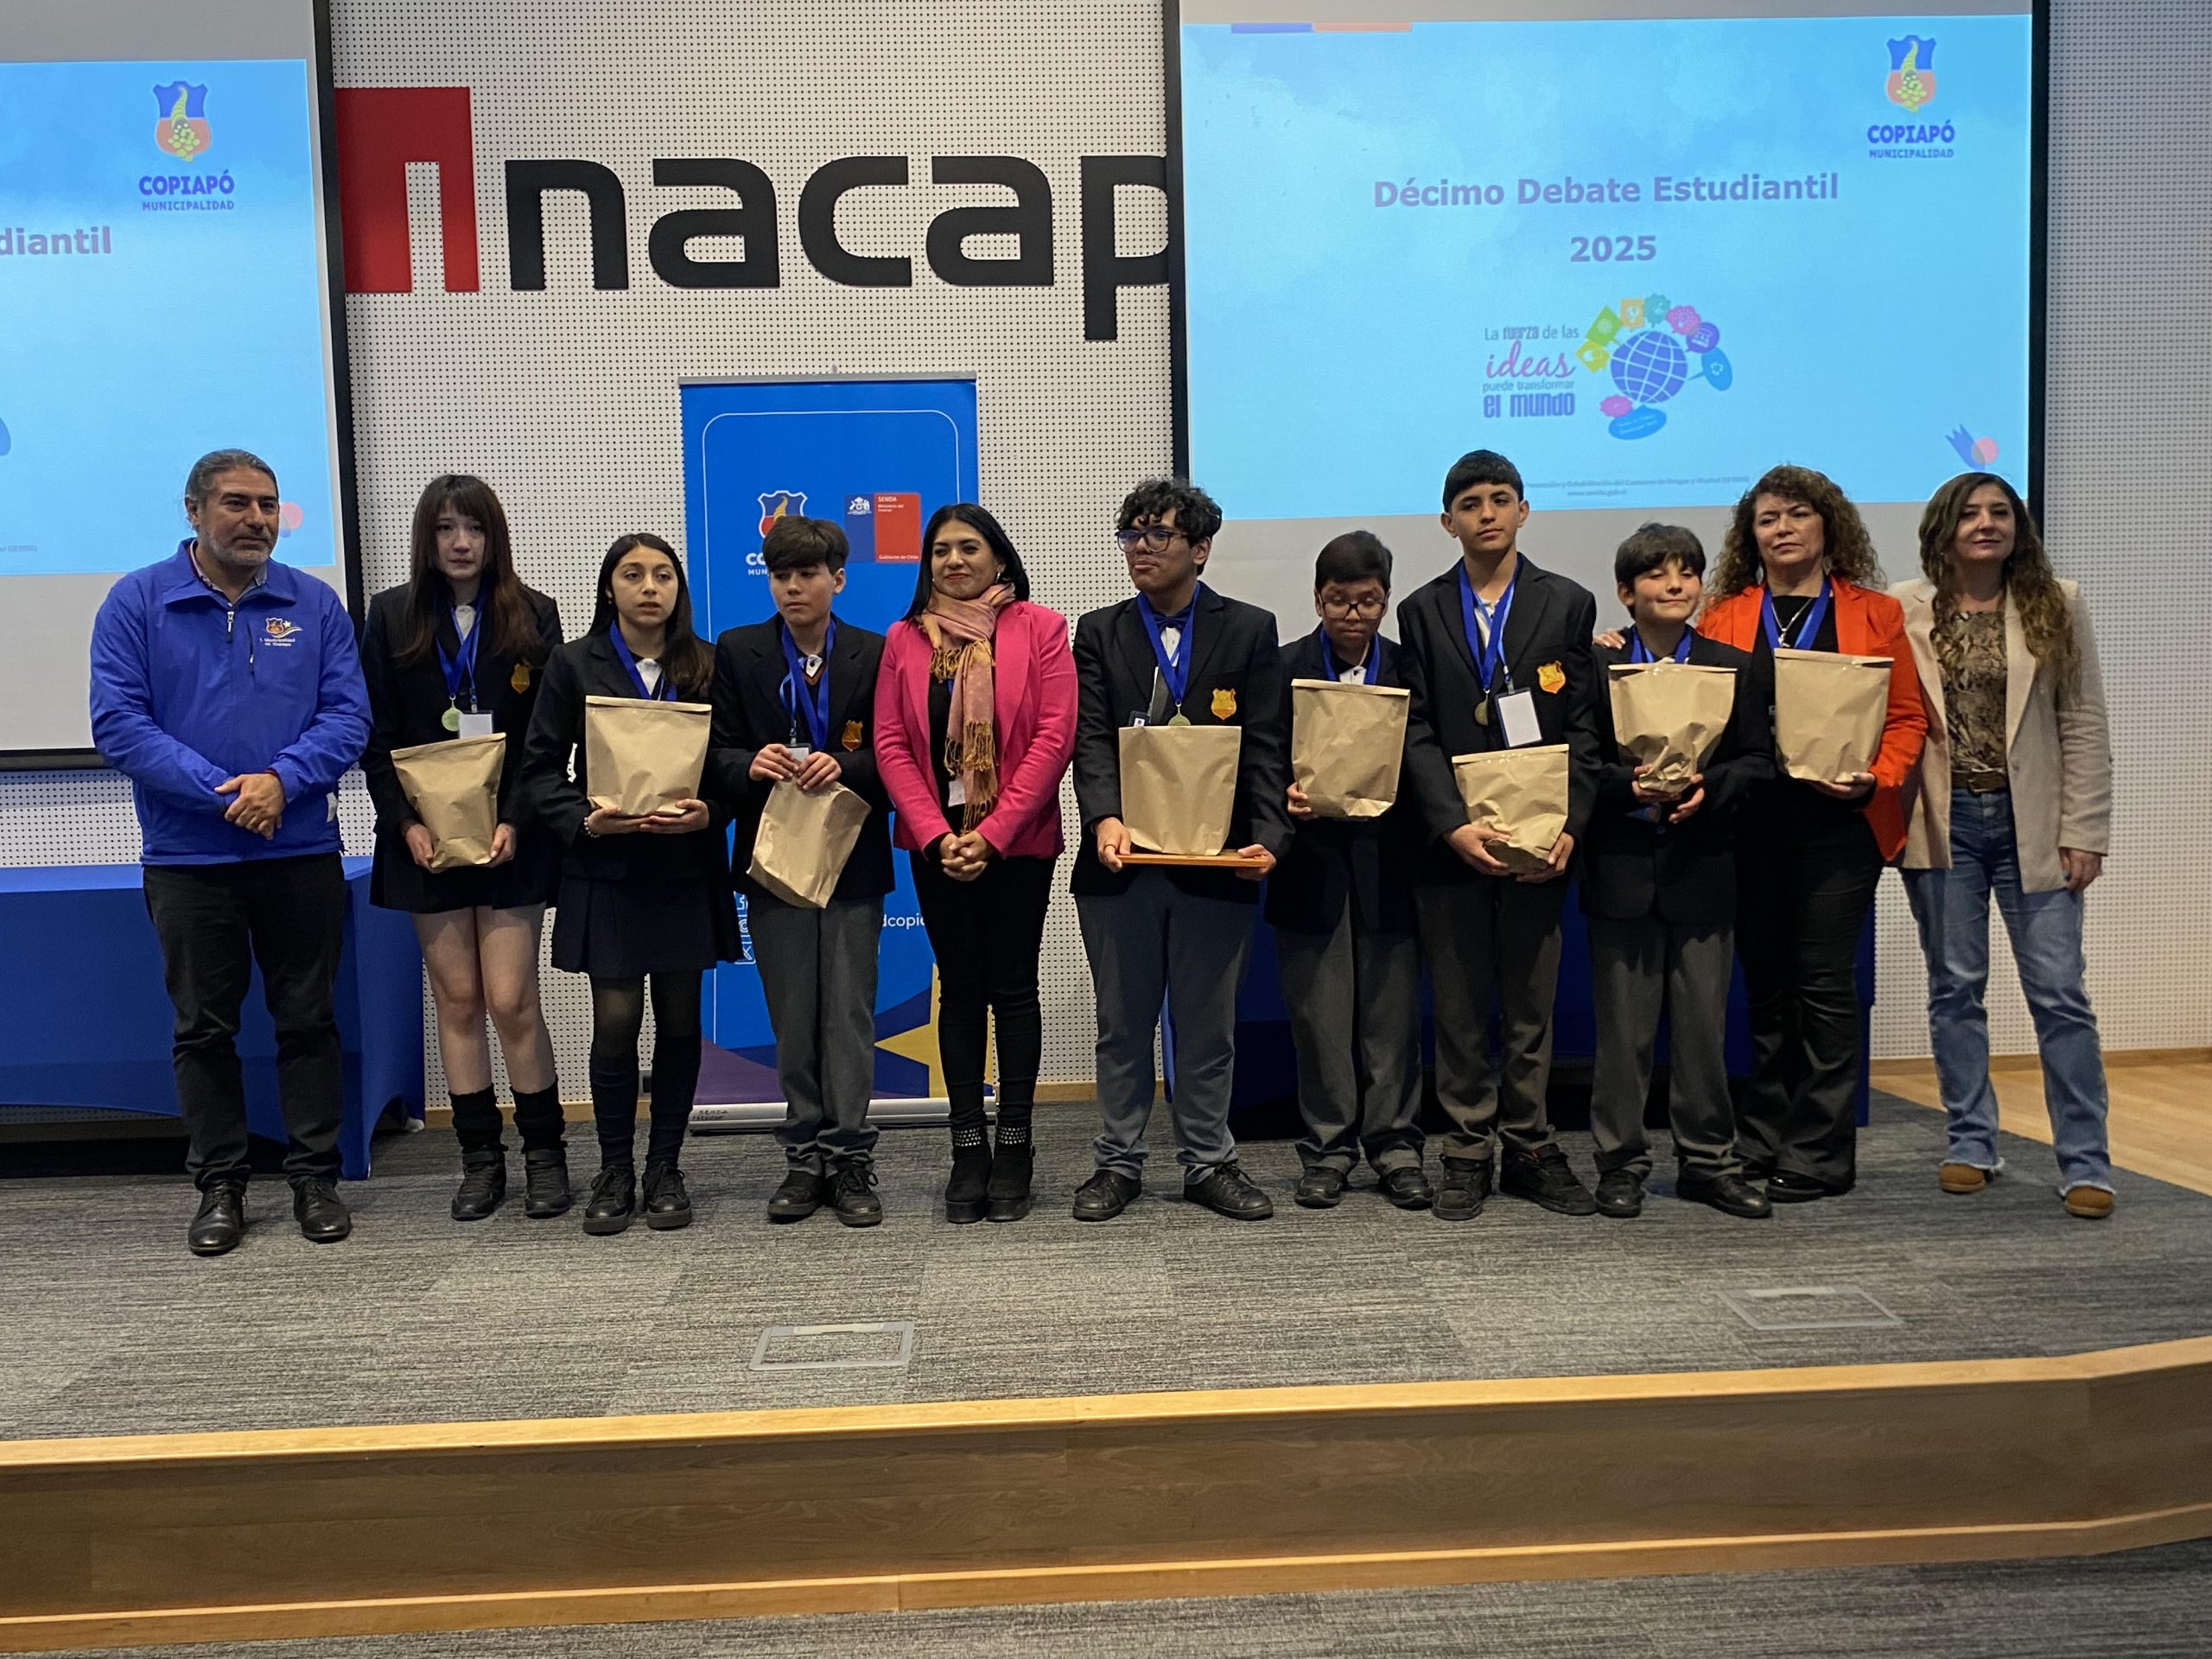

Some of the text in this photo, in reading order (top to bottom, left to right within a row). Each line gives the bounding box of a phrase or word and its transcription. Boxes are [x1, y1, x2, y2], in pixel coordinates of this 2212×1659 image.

[1866, 118, 1956, 144] COPIAPÓ
[1868, 148, 1955, 159] MUNICIPALIDAD
[137, 168, 235, 195] COPIAPÓ
[1373, 172, 1840, 208] Décimo Debate Estudiantil
[141, 200, 235, 212] MUNICIPALIDAD
[1569, 235, 1658, 263] 2025
[1484, 327, 1499, 341] La
[1541, 325, 1558, 340] de
[1561, 324, 1580, 340] las
[1485, 340, 1577, 378] ideas
[1482, 378, 1575, 394] puede transformar
[1483, 392, 1576, 418] el mundo
